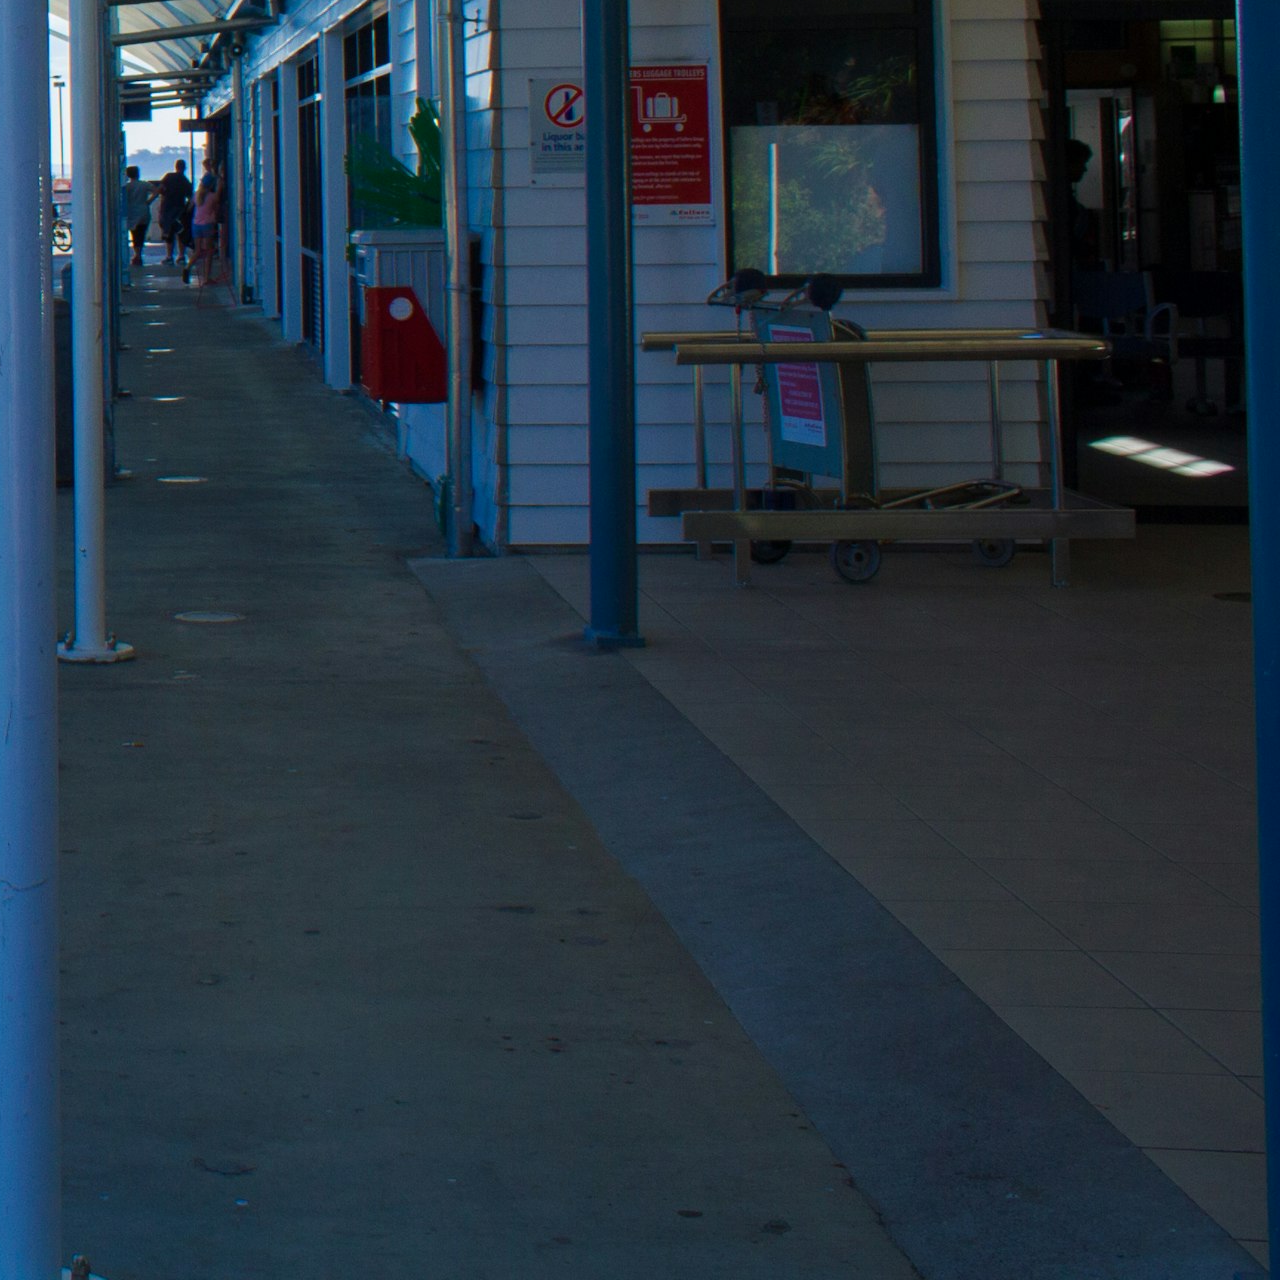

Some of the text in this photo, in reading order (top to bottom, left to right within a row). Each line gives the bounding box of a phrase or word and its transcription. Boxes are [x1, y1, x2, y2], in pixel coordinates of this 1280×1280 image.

[642, 68, 673, 78] LUGGAGE
[674, 68, 705, 77] TROLLEYS
[543, 132, 573, 142] Liquor
[542, 143, 552, 152] in
[553, 142, 572, 151] this
